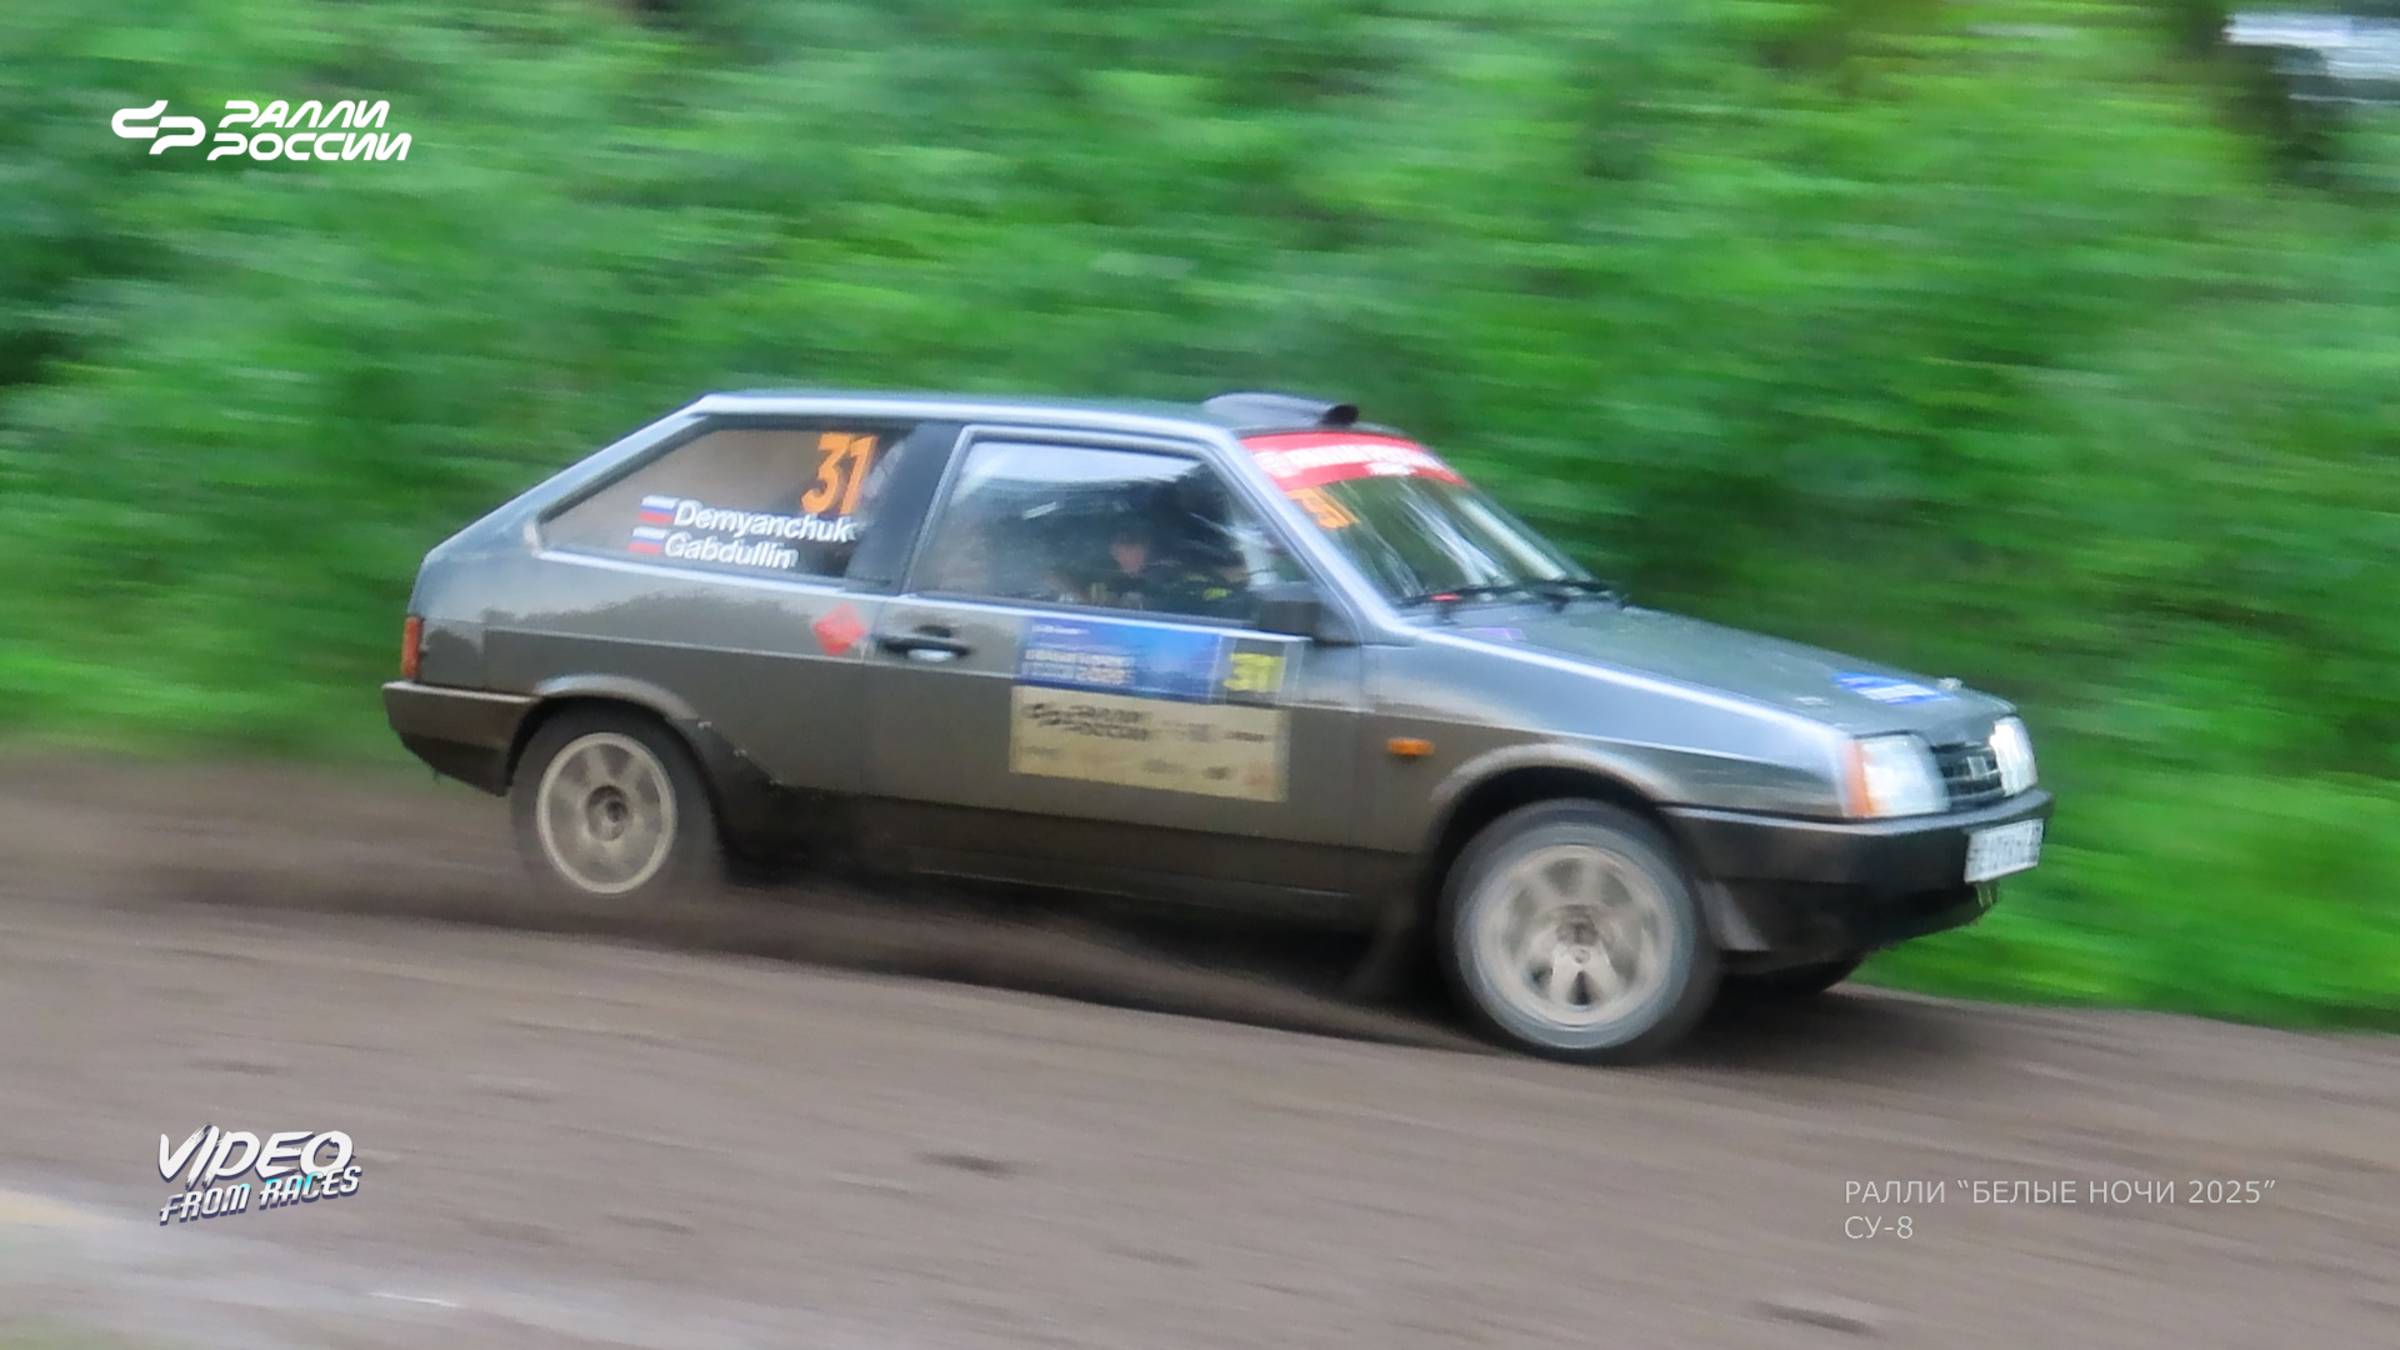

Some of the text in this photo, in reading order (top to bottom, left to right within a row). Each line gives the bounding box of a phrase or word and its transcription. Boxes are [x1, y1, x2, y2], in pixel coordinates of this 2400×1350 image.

[801, 431, 879, 517] 31
[673, 499, 858, 544] Demyanchuk
[664, 531, 800, 570] Gabdullin
[1223, 652, 1283, 693] 31
